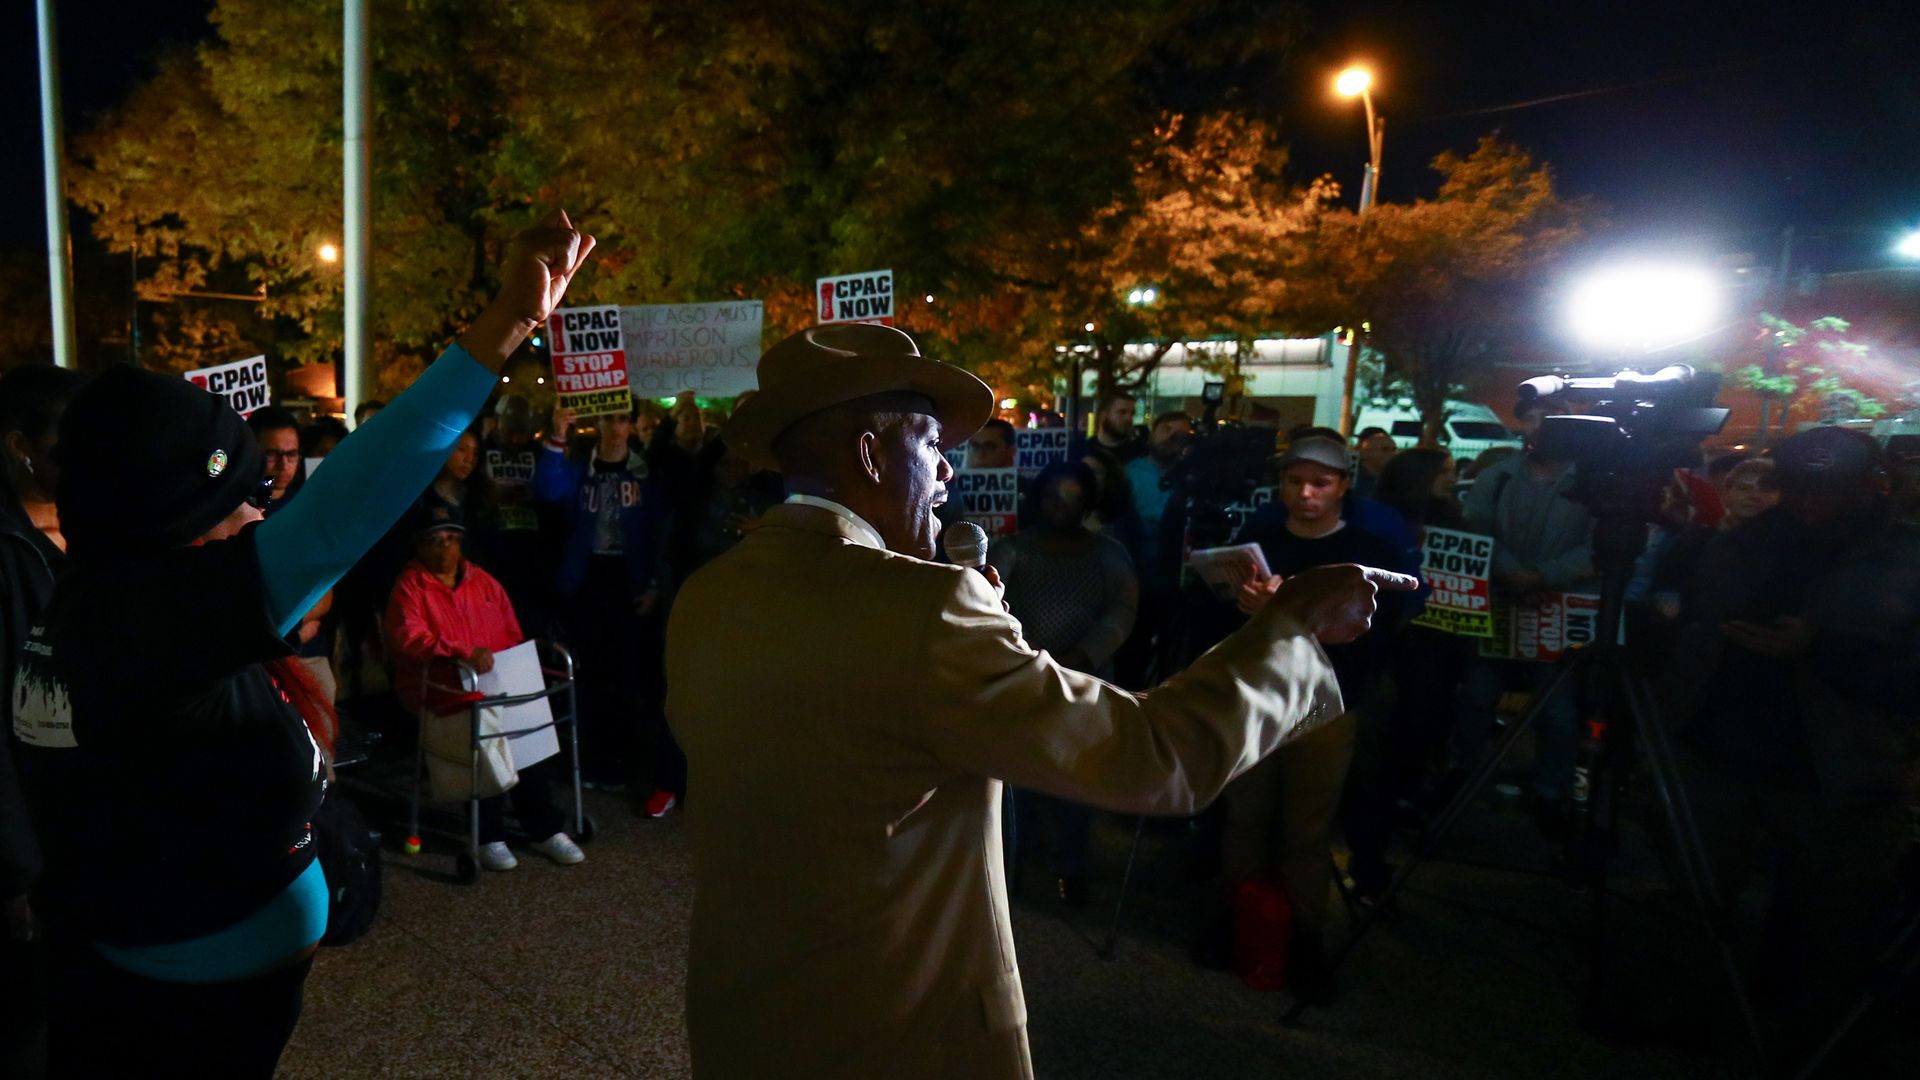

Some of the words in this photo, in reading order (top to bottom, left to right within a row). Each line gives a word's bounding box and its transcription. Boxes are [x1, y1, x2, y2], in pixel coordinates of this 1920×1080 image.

[837, 276, 890, 298] CPAC
[715, 304, 762, 322] MUST
[840, 296, 890, 318] NOW
[565, 310, 618, 331] CPAC
[570, 331, 619, 352] NOW
[563, 354, 614, 374] STOP
[209, 363, 264, 392] CPAC
[557, 369, 625, 391] TRUMP
[225, 385, 265, 411] OW
[561, 390, 628, 408] BOYCOTT
[1018, 432, 1066, 448] CPAC
[1020, 450, 1066, 467] NOW
[494, 466, 532, 478] NOW
[958, 474, 1015, 491] CPAC
[962, 494, 1014, 512] NOW
[1428, 532, 1490, 558] CPAC
[1429, 551, 1487, 577] NOW
[1425, 591, 1487, 609] UMP
[1566, 613, 1591, 642] NO
